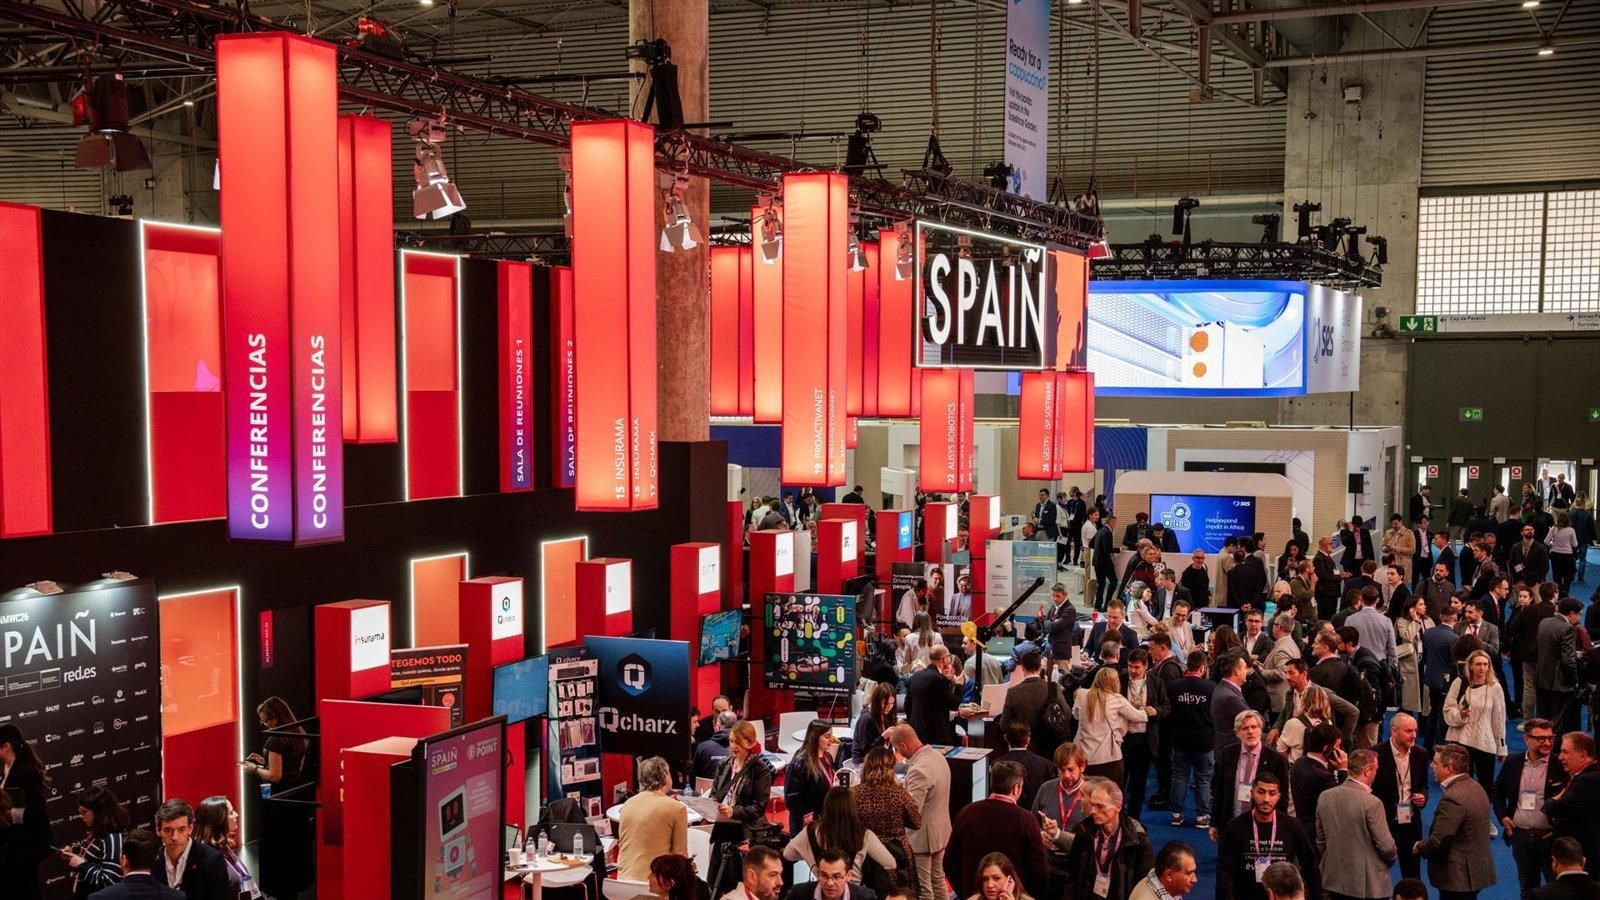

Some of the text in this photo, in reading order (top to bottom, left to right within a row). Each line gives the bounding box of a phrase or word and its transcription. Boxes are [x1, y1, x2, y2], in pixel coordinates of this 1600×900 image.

[1010, 38, 1027, 66] Ready
[1028, 50, 1036, 68] for
[927, 248, 1045, 351] SPAIÑ
[567, 339, 573, 347] 2
[1044, 381, 1053, 418] SOFTWARE
[248, 333, 270, 530] CONFERENCIAS
[310, 335, 327, 529] CONFERENCIAS
[516, 429, 523, 446] DE
[814, 388, 823, 475] 19 PROACTIVANET
[947, 402, 956, 484] 22 ALISYS ROBOTICS
[516, 449, 524, 482] SALA
[614, 417, 625, 500] 15 INSURAMA
[649, 484, 656, 498] 17
[354, 632, 385, 646] insurama
[436, 654, 462, 663] TODO
[63, 666, 97, 683] red.es
[623, 663, 645, 690] Q
[1177, 692, 1207, 704] alisys
[598, 706, 677, 735] Qcharx
[431, 746, 458, 768] SPAIÑ
[476, 742, 497, 758] POINT
